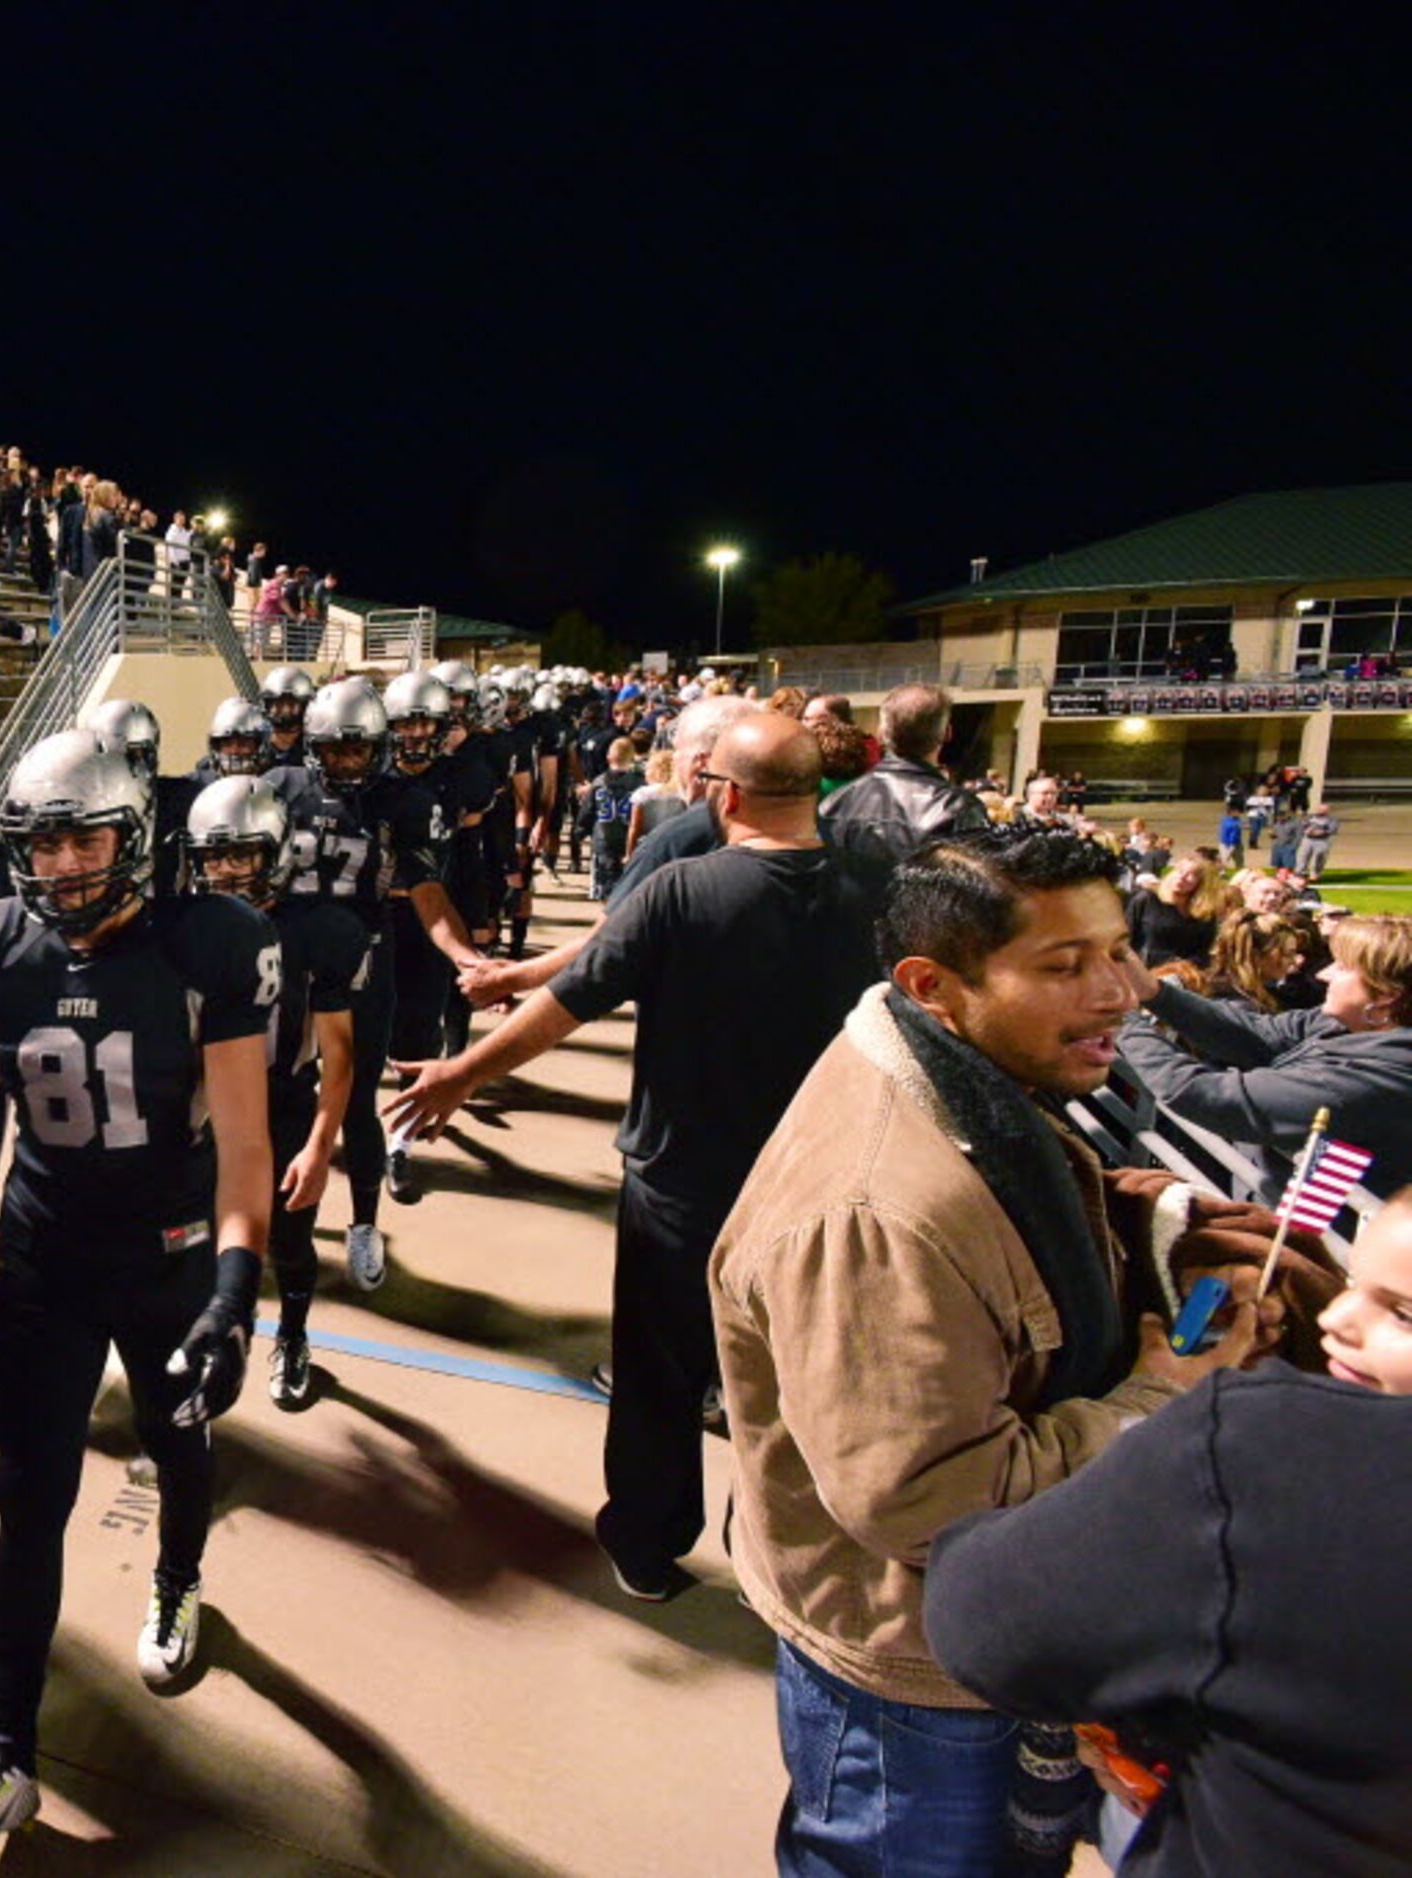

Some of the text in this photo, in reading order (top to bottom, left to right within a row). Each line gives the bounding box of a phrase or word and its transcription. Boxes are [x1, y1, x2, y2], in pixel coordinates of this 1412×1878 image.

[594, 788, 632, 823] 34
[253, 942, 282, 1005] 8
[57, 998, 98, 1018] GUYER
[17, 1025, 149, 1149] 81
